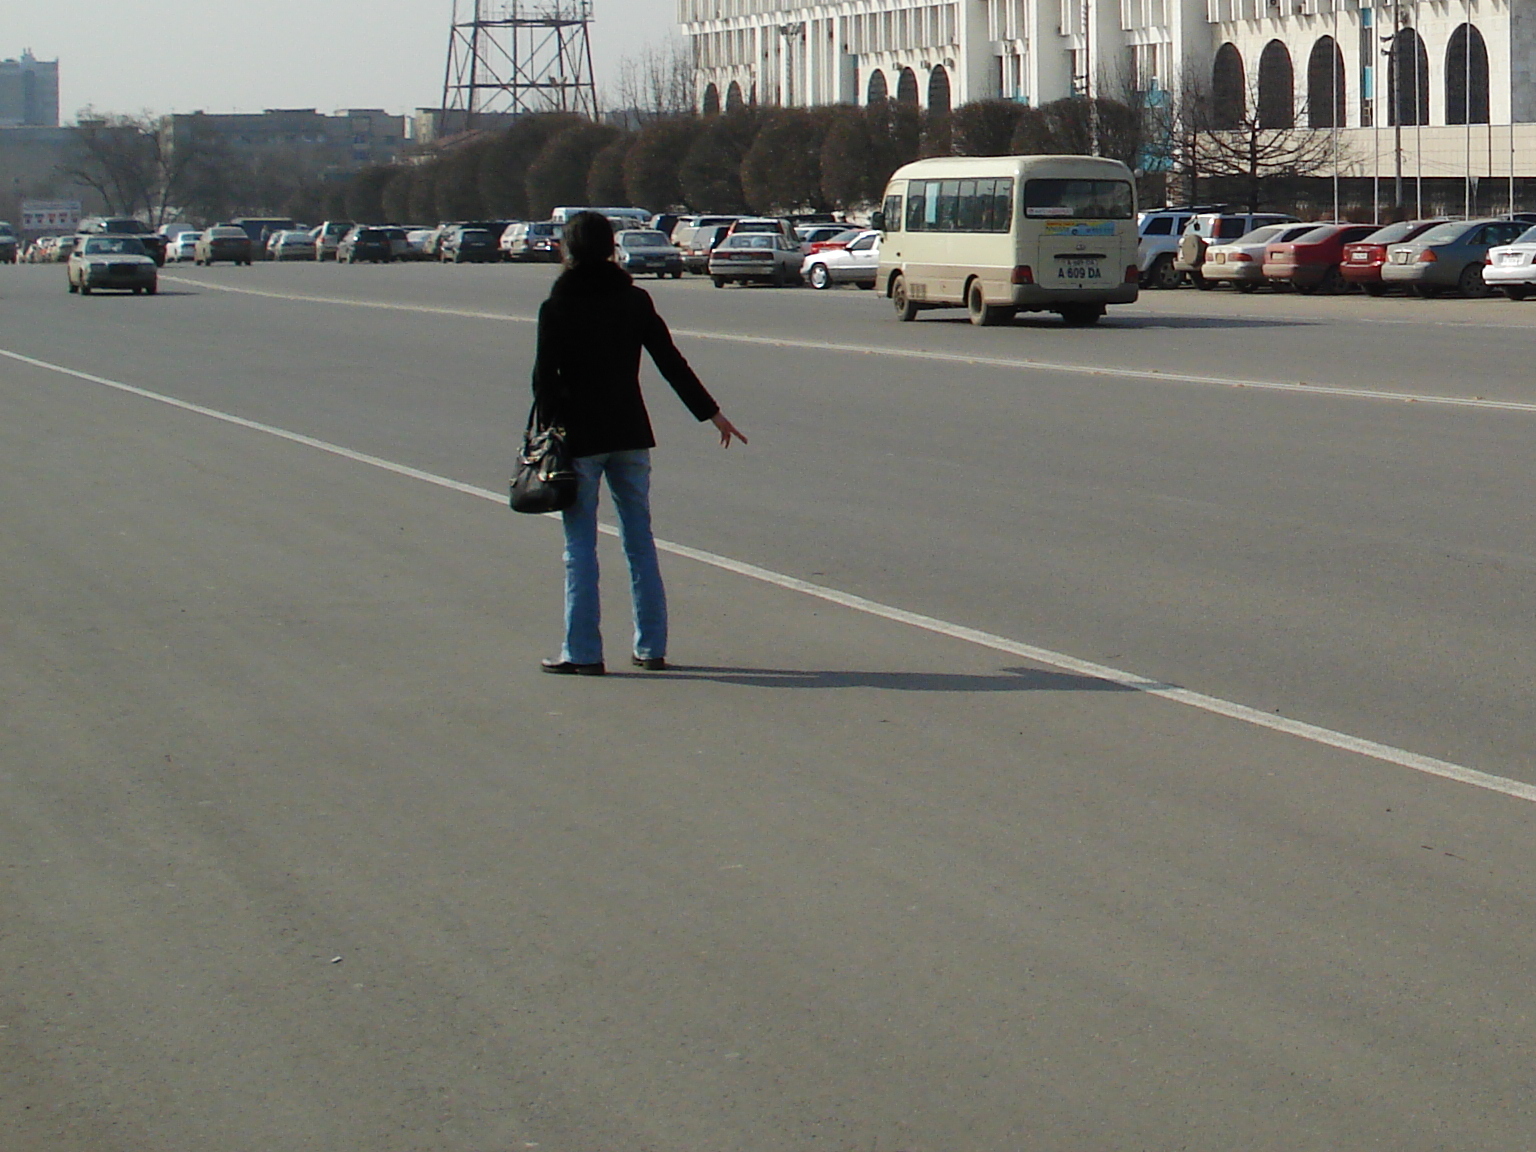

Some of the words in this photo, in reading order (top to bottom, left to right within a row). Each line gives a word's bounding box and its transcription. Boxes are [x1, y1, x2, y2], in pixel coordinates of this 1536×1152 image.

[1058, 268, 1064, 278] A
[1068, 268, 1085, 279] 609
[1088, 268, 1101, 278] DA
